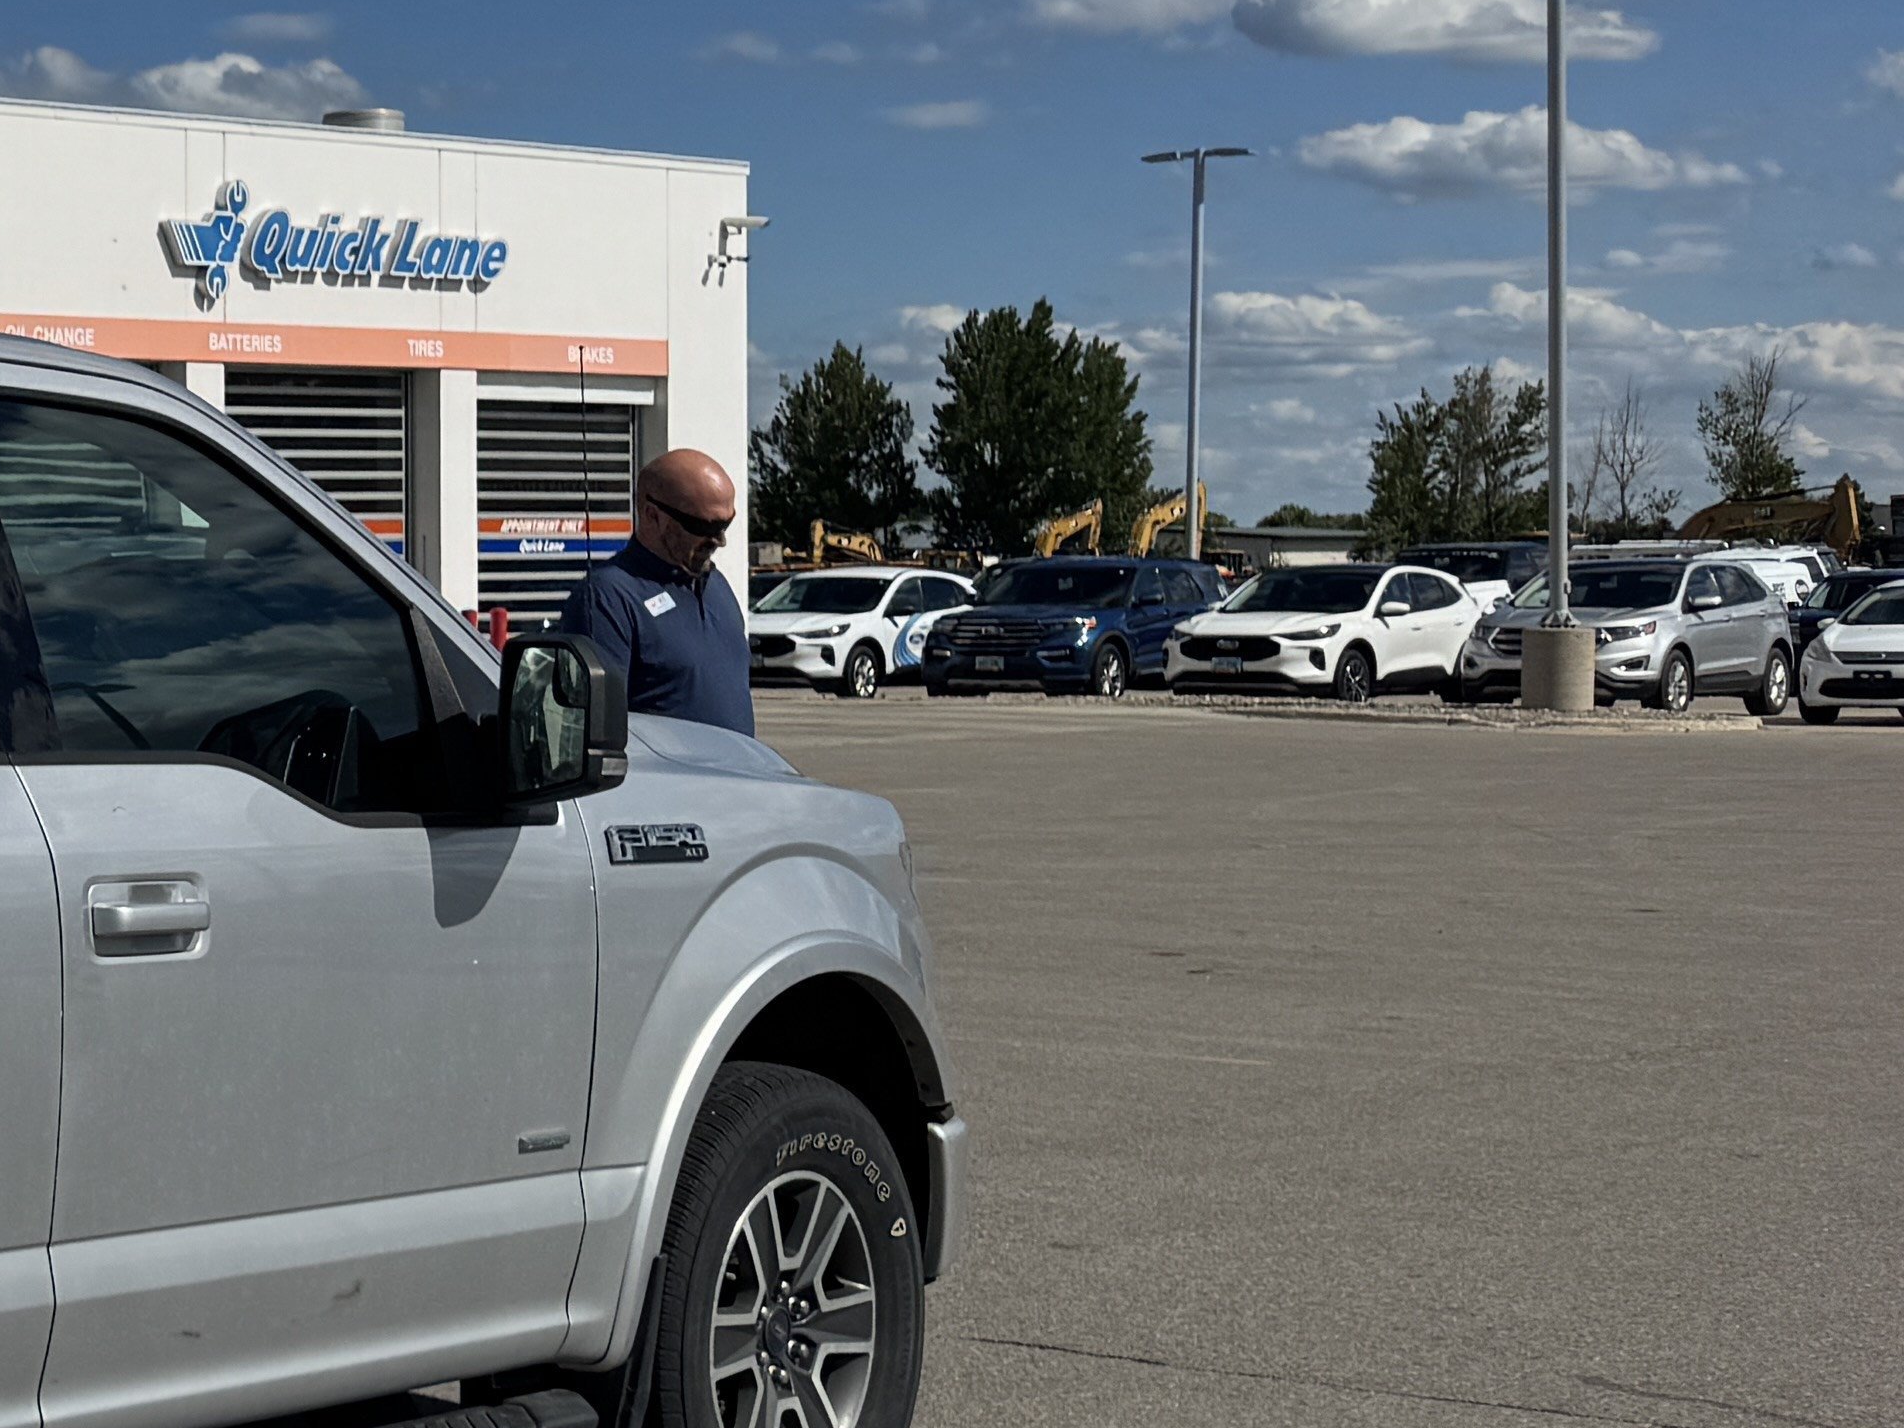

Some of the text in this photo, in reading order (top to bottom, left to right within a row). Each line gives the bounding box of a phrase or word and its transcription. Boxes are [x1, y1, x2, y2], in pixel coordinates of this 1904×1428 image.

[250, 208, 509, 281] Quick Lane
[32, 326, 95, 347] CHANGE
[209, 332, 282, 352] BATTERIES
[407, 339, 444, 358] TIRES
[685, 847, 704, 858] XLT
[776, 1132, 891, 1203] Firestone
